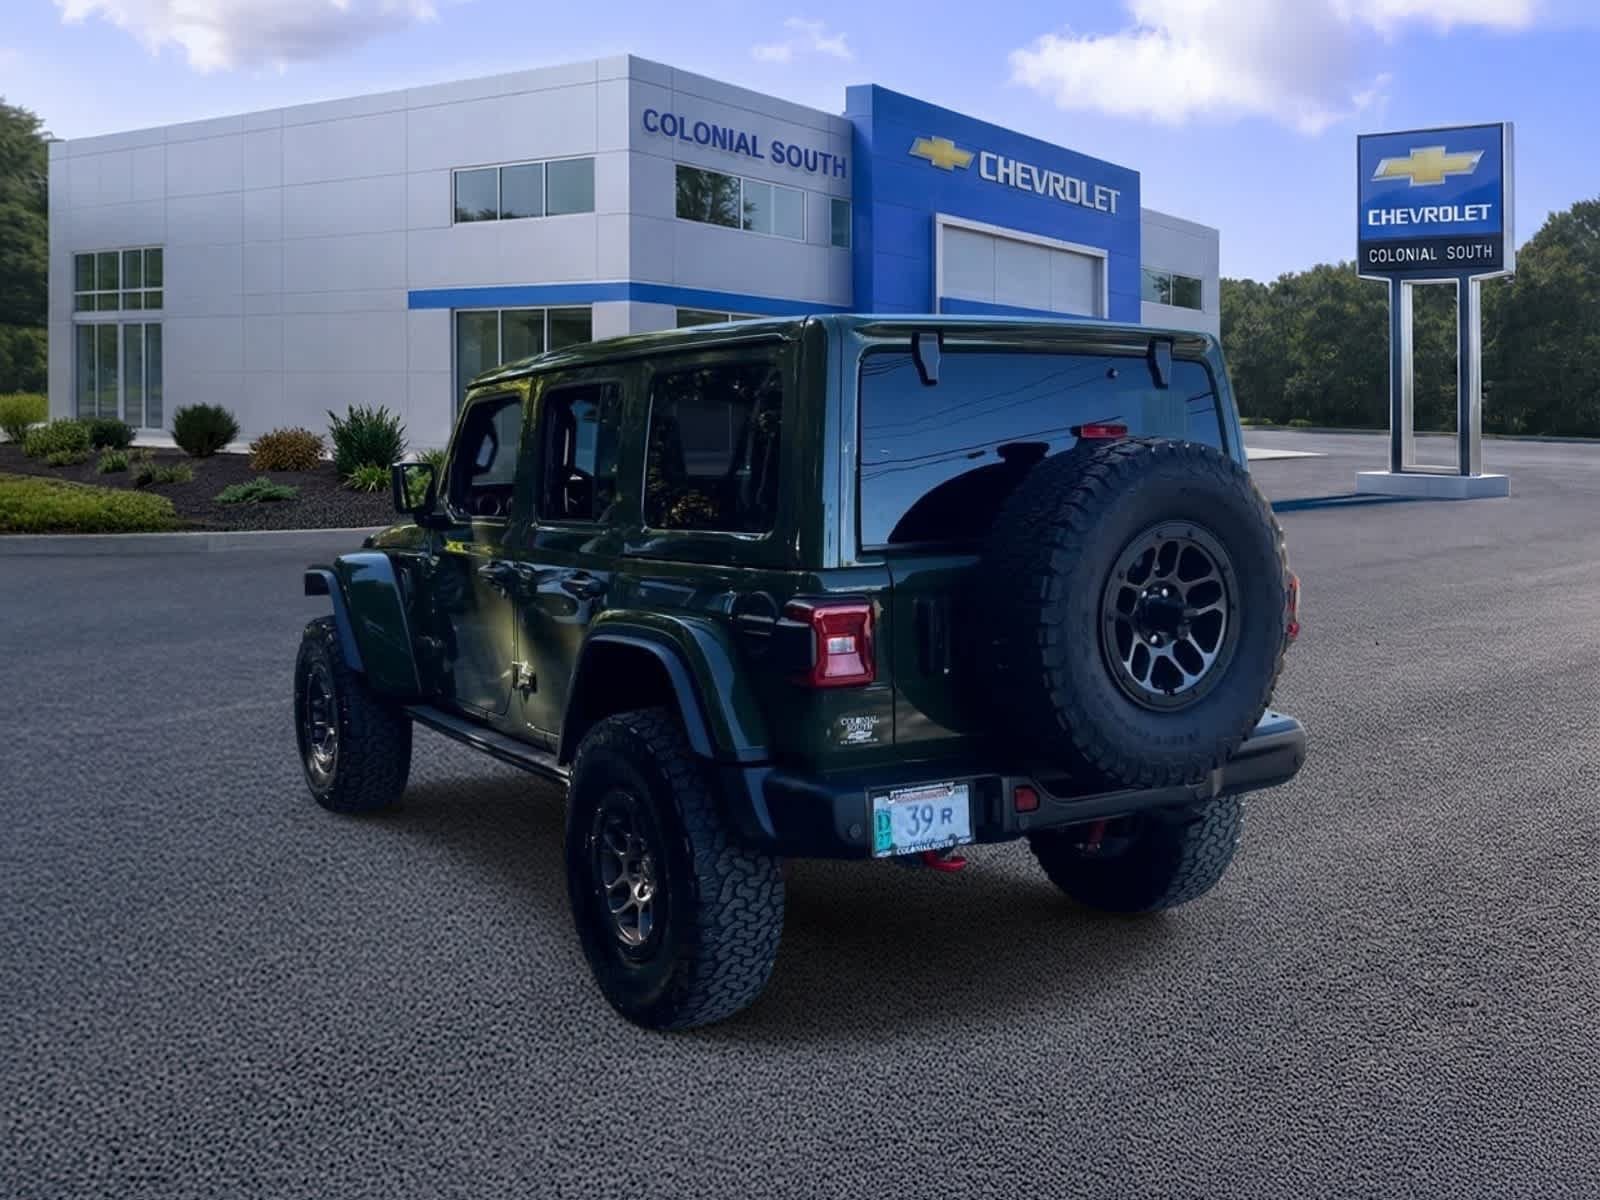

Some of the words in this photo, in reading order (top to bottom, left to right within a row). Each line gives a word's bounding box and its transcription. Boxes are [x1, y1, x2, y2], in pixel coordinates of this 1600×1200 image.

[643, 108, 765, 160] COLONIAL
[771, 140, 847, 179] SOUTH
[979, 150, 1121, 214] CHEVROLET
[1368, 203, 1492, 226] CHEVROLET
[1368, 247, 1438, 263] COLONIAL
[1446, 244, 1493, 260] SOUTH
[906, 804, 933, 837] 39
[941, 807, 953, 825] R
